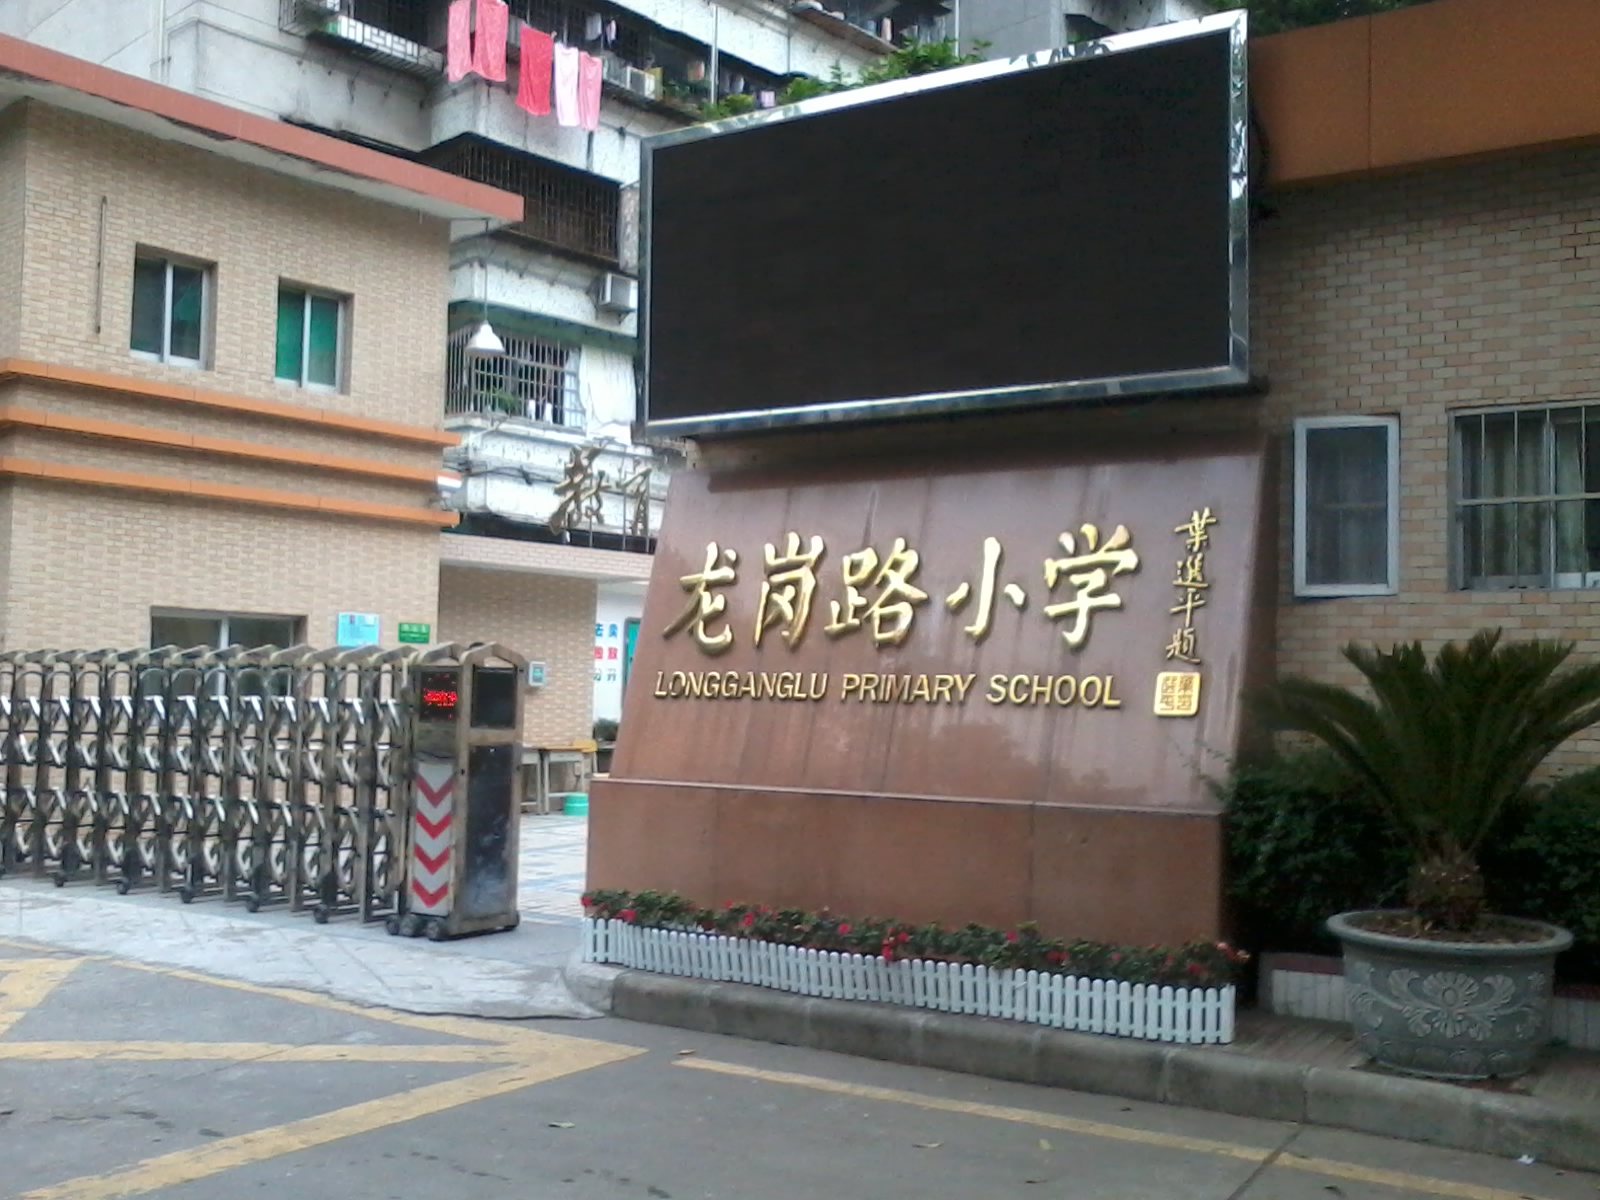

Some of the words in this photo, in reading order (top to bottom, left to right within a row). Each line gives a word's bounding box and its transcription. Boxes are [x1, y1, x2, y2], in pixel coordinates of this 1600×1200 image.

[662, 523, 1139, 653] 龙岗路小学
[654, 670, 828, 700] LONGGANGLU
[840, 673, 976, 705] PRIMARY
[985, 674, 1122, 708] SCHOOL
